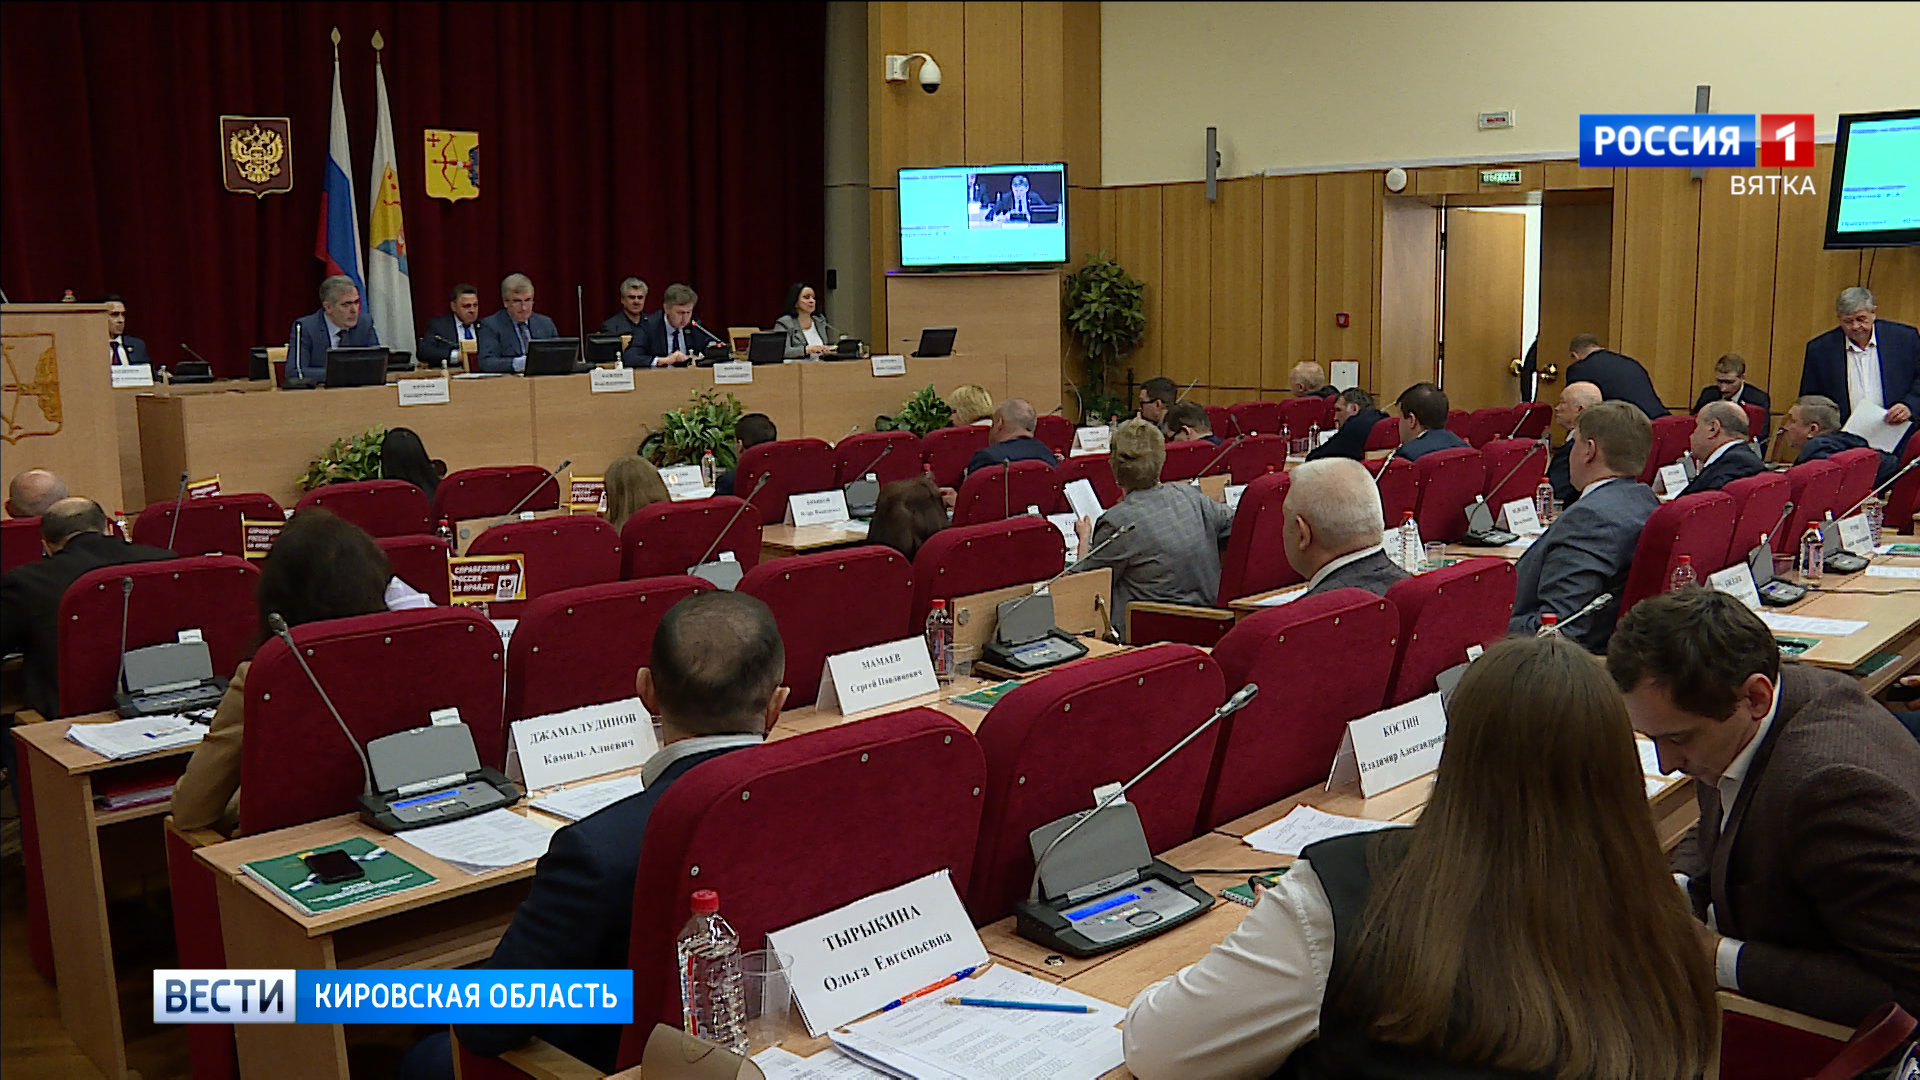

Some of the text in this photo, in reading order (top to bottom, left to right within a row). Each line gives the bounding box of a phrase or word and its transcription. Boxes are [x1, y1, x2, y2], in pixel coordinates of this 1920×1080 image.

[861, 653, 901, 670] МАМАЕВ
[850, 679, 877, 694] Сергей
[530, 713, 637, 745] ДЖАМАЛУДИНОВ
[1383, 715, 1420, 738] КОСТИН
[543, 738, 635, 766] Камиль Алиевич
[1360, 751, 1399, 774] Владимир
[822, 904, 921, 952] ТЫРЫКИНА
[823, 931, 953, 992] Ольга Евгеньевна
